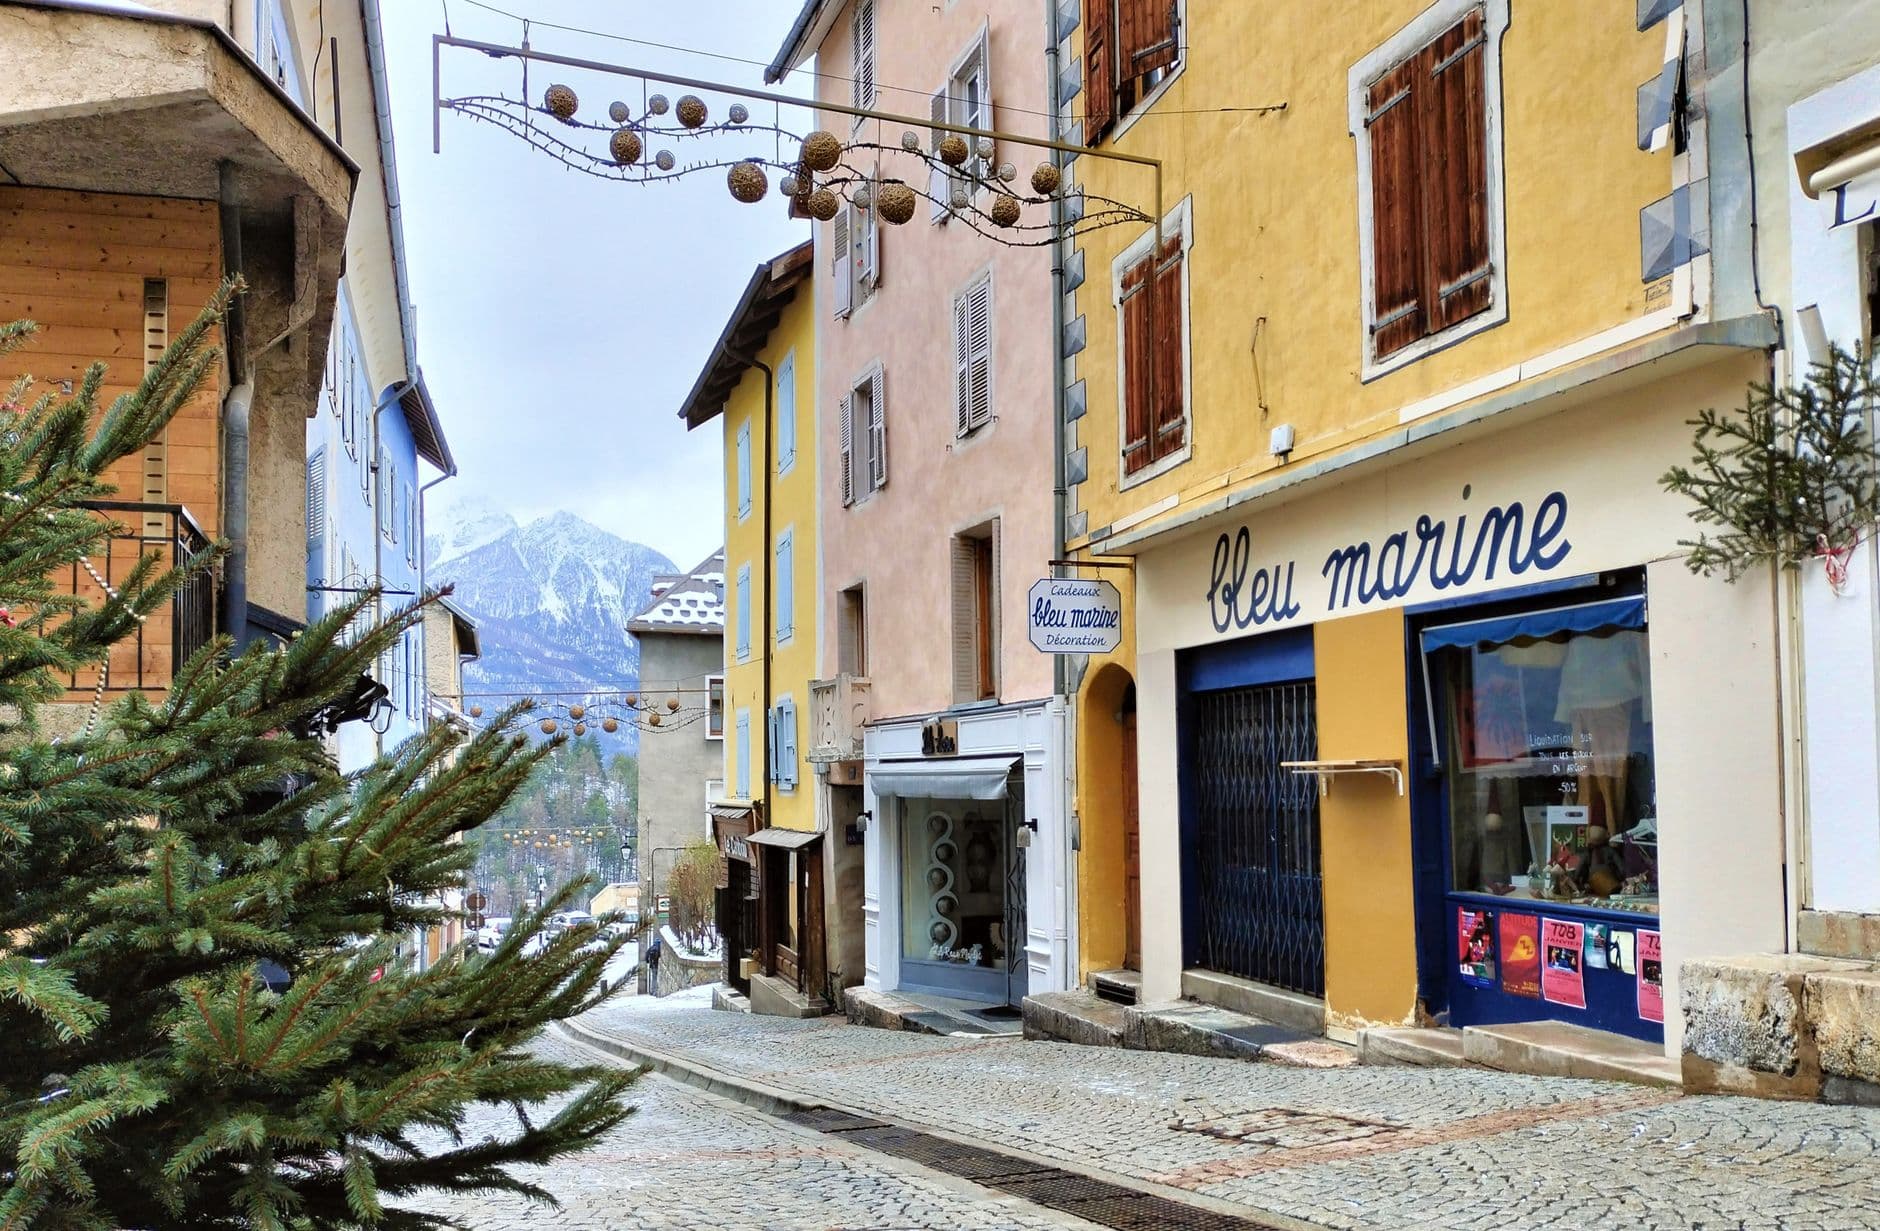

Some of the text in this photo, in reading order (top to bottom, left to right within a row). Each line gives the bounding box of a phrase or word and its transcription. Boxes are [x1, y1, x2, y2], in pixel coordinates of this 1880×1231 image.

[1206, 483, 1573, 634] bleu marine
[1051, 583, 1101, 597] Cadeaux
[1032, 597, 1119, 629] bleu marine
[1046, 633, 1107, 646] Décoration
